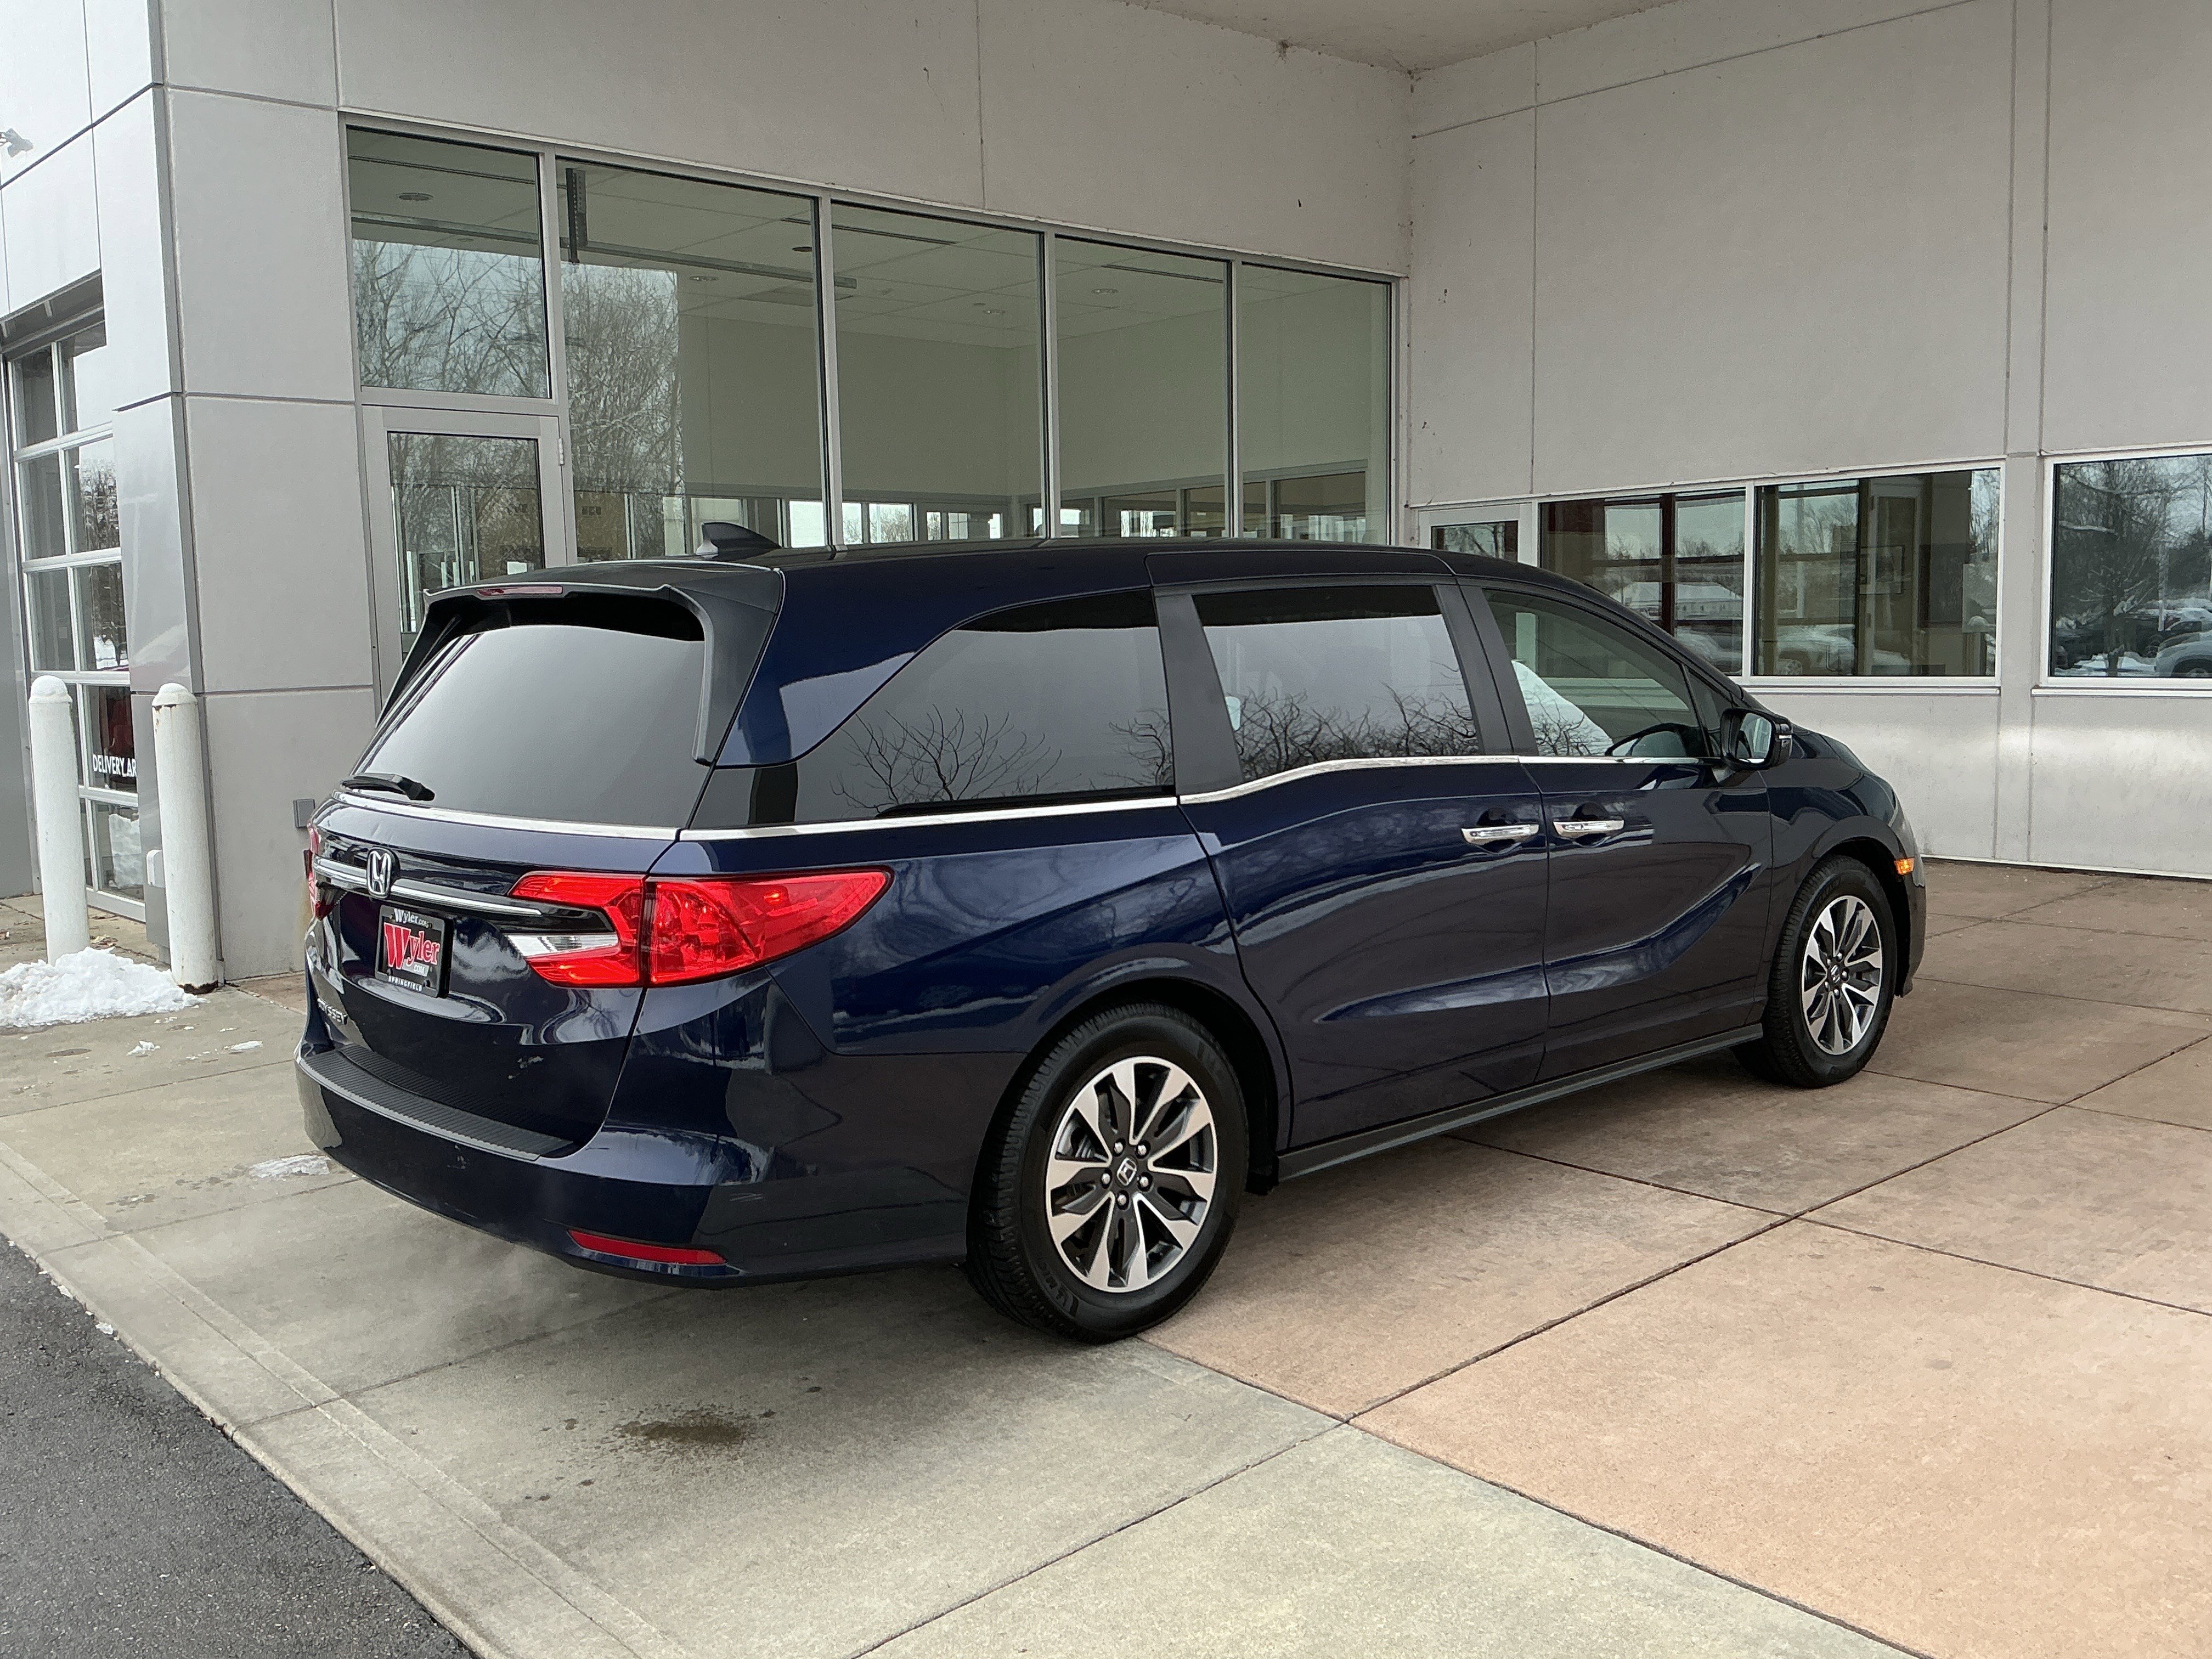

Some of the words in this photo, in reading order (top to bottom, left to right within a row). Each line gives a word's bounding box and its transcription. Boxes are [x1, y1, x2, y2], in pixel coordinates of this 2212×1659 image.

[92, 754, 125, 776] DELIVERY
[384, 922, 441, 970] Wyler
[388, 975, 422, 992] SPRINGFIELD
